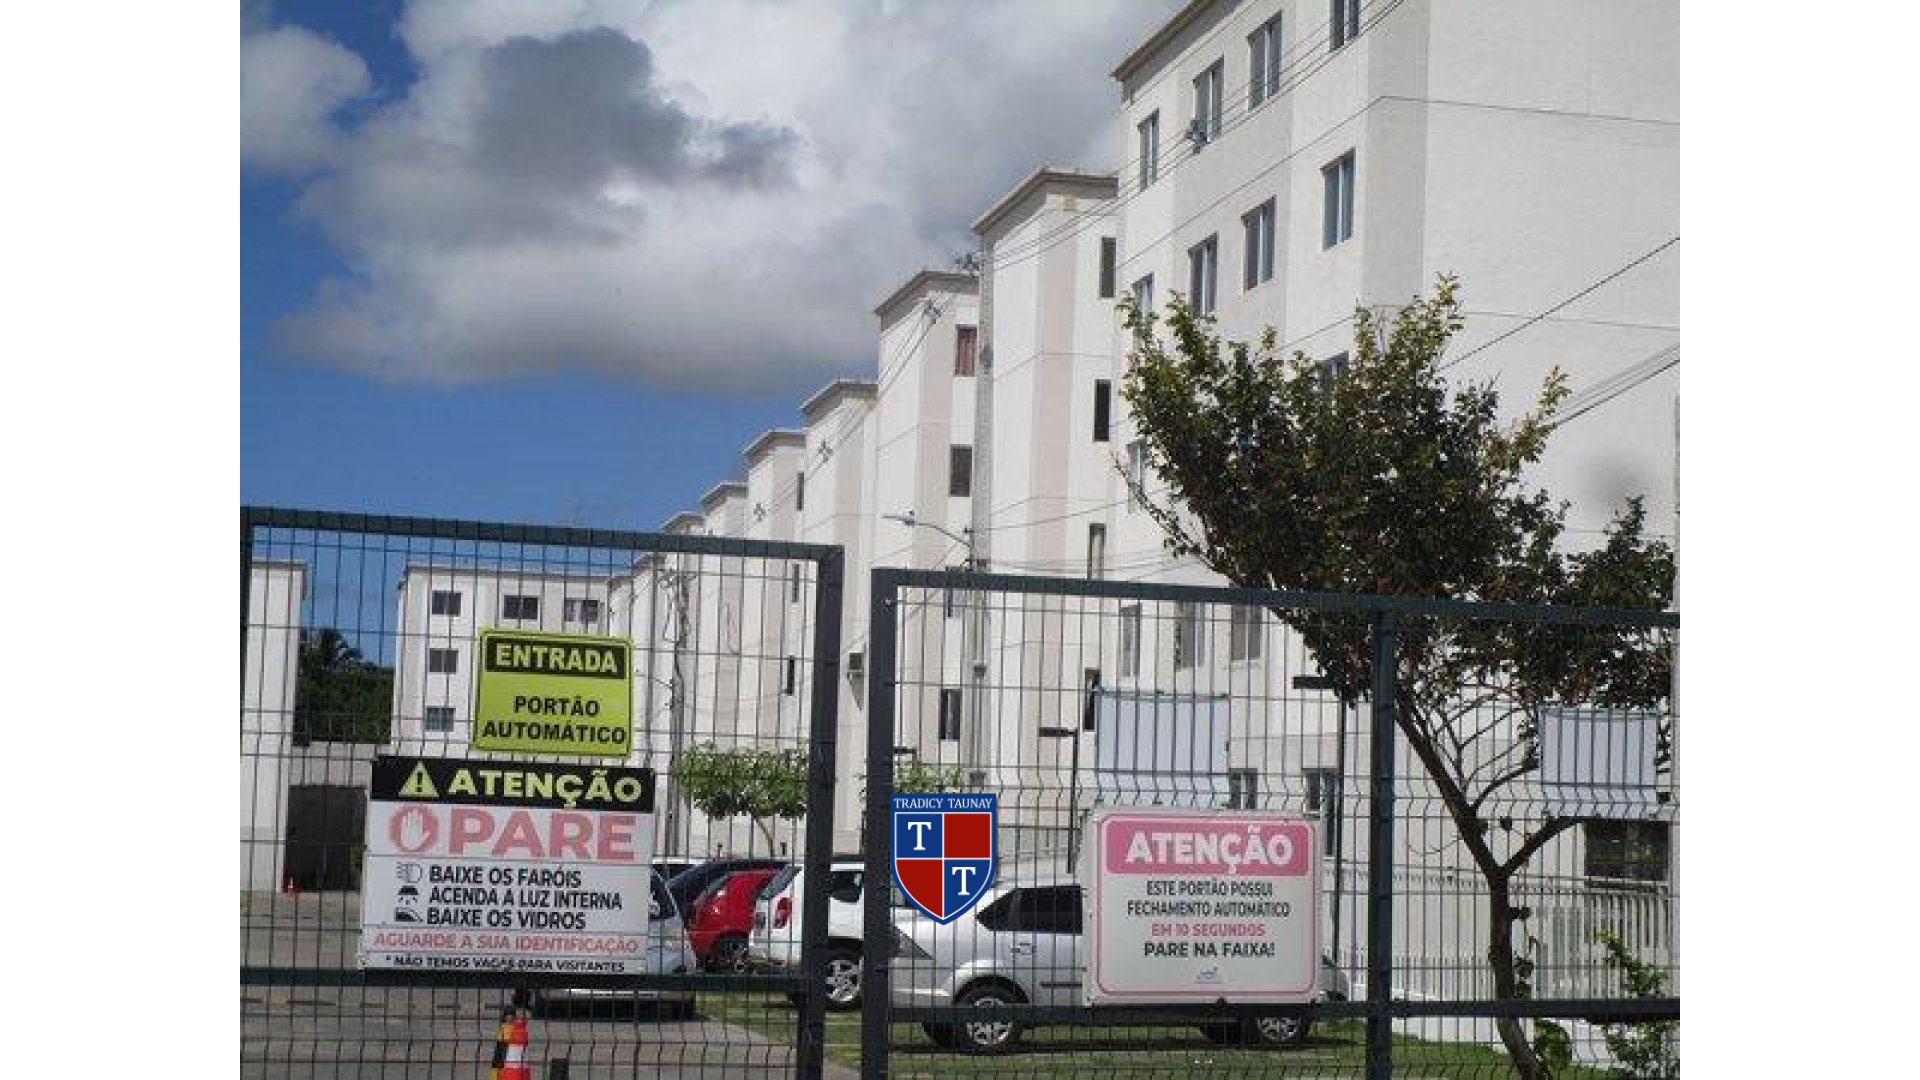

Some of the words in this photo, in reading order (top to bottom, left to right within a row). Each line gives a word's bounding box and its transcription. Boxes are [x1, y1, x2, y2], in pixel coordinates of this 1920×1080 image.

[495, 644, 618, 672] ENTRADA
[513, 695, 600, 716] PORTÃO
[482, 720, 627, 744] AUTOMÁTICO
[448, 769, 642, 808] ATENÇÃO
[448, 807, 637, 862] PARE
[1125, 825, 1294, 874] ATENÇÃO
[429, 865, 483, 885] BAIXE
[488, 868, 514, 886] OS
[517, 866, 582, 889] FARÓIS
[1146, 880, 1177, 896] ESTE
[1178, 877, 1227, 896] PORTÃO
[1230, 881, 1273, 898] POSSUI
[429, 886, 499, 905] ACENDA
[501, 888, 515, 906] A
[520, 890, 550, 908] LUZ
[553, 892, 622, 910] INTERNA
[1127, 900, 1211, 917] FECHAMENTO
[426, 907, 483, 927] BAIXE
[486, 909, 513, 928] OS
[517, 912, 587, 930] VIDROS
[1151, 924, 1172, 937] EM
[1175, 923, 1190, 937] 10
[1191, 923, 1266, 937] SEGUNDOS
[374, 932, 458, 949] AGUARDE
[460, 935, 474, 949] A
[477, 935, 511, 950] SUA
[515, 935, 640, 955] IDENTIFICAÇÃO
[1144, 942, 1189, 957] PARE
[1194, 942, 1218, 957] NA
[1222, 942, 1276, 957] FAIXA!
